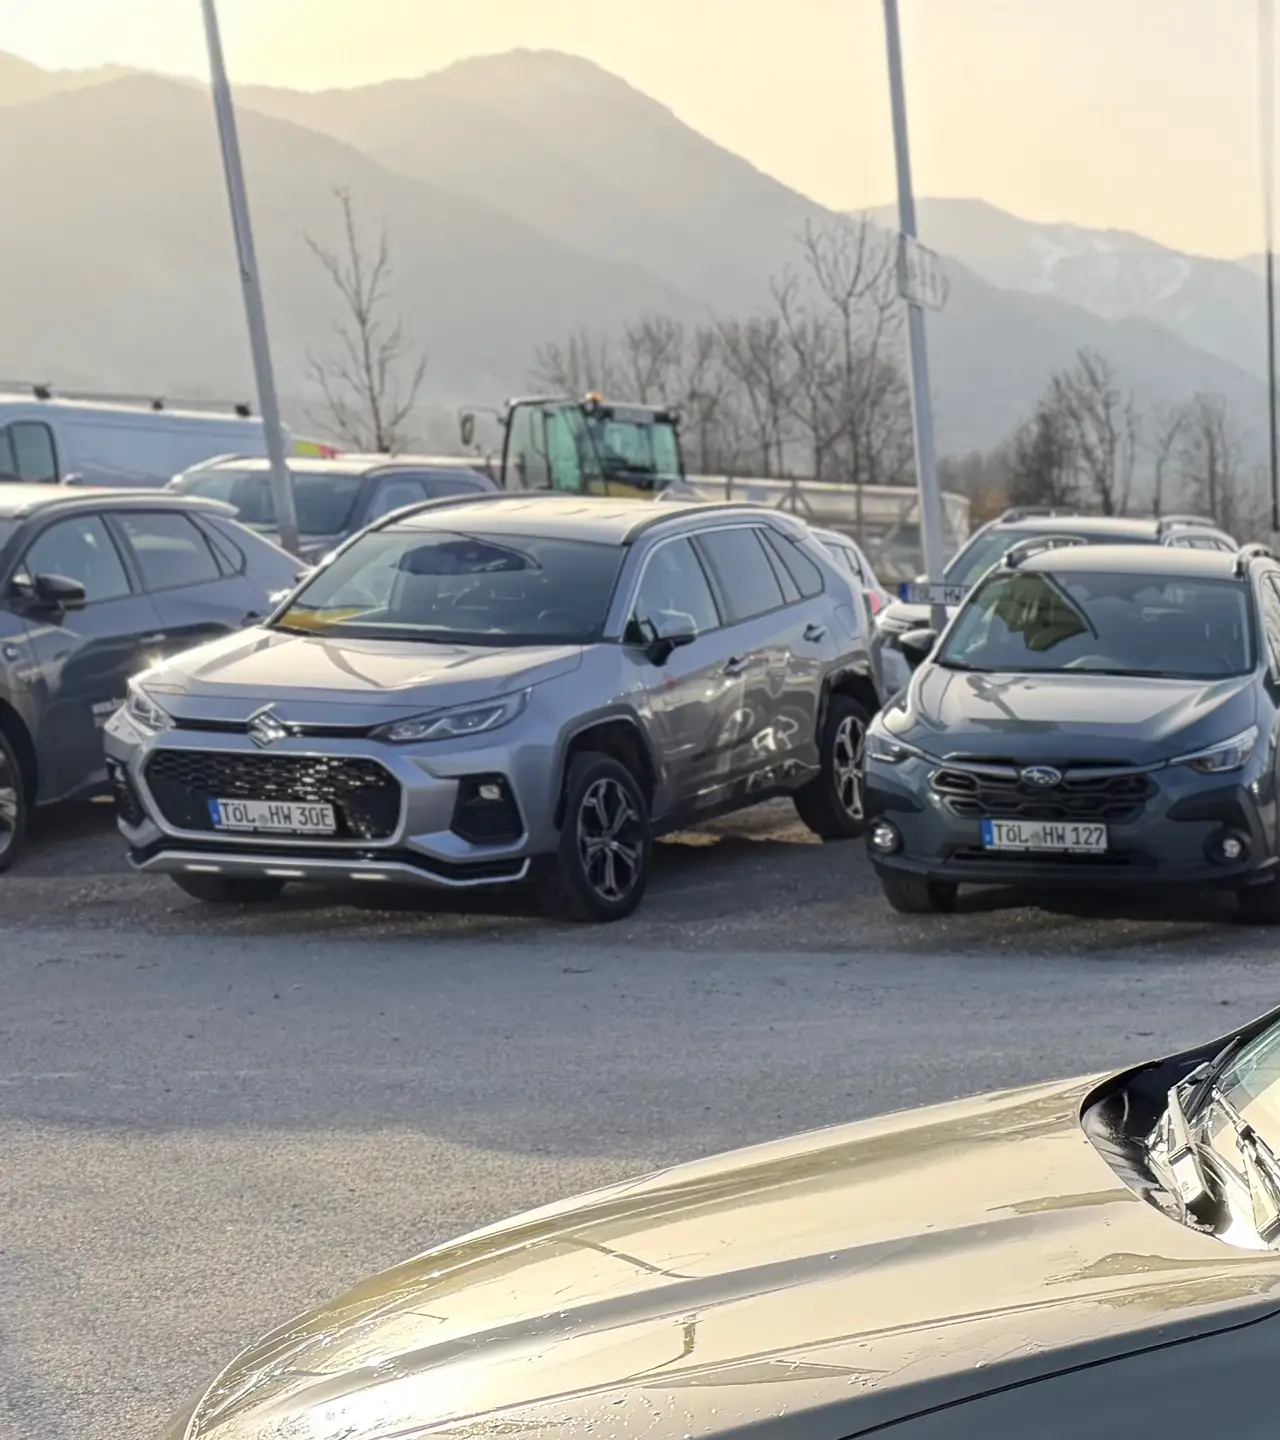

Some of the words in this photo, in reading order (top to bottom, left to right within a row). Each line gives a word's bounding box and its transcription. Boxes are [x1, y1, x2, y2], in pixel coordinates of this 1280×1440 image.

[220, 802, 256, 823] TÖL
[994, 824, 1029, 843] TÖL
[1042, 824, 1066, 845] HW
[1070, 826, 1104, 846] 127
